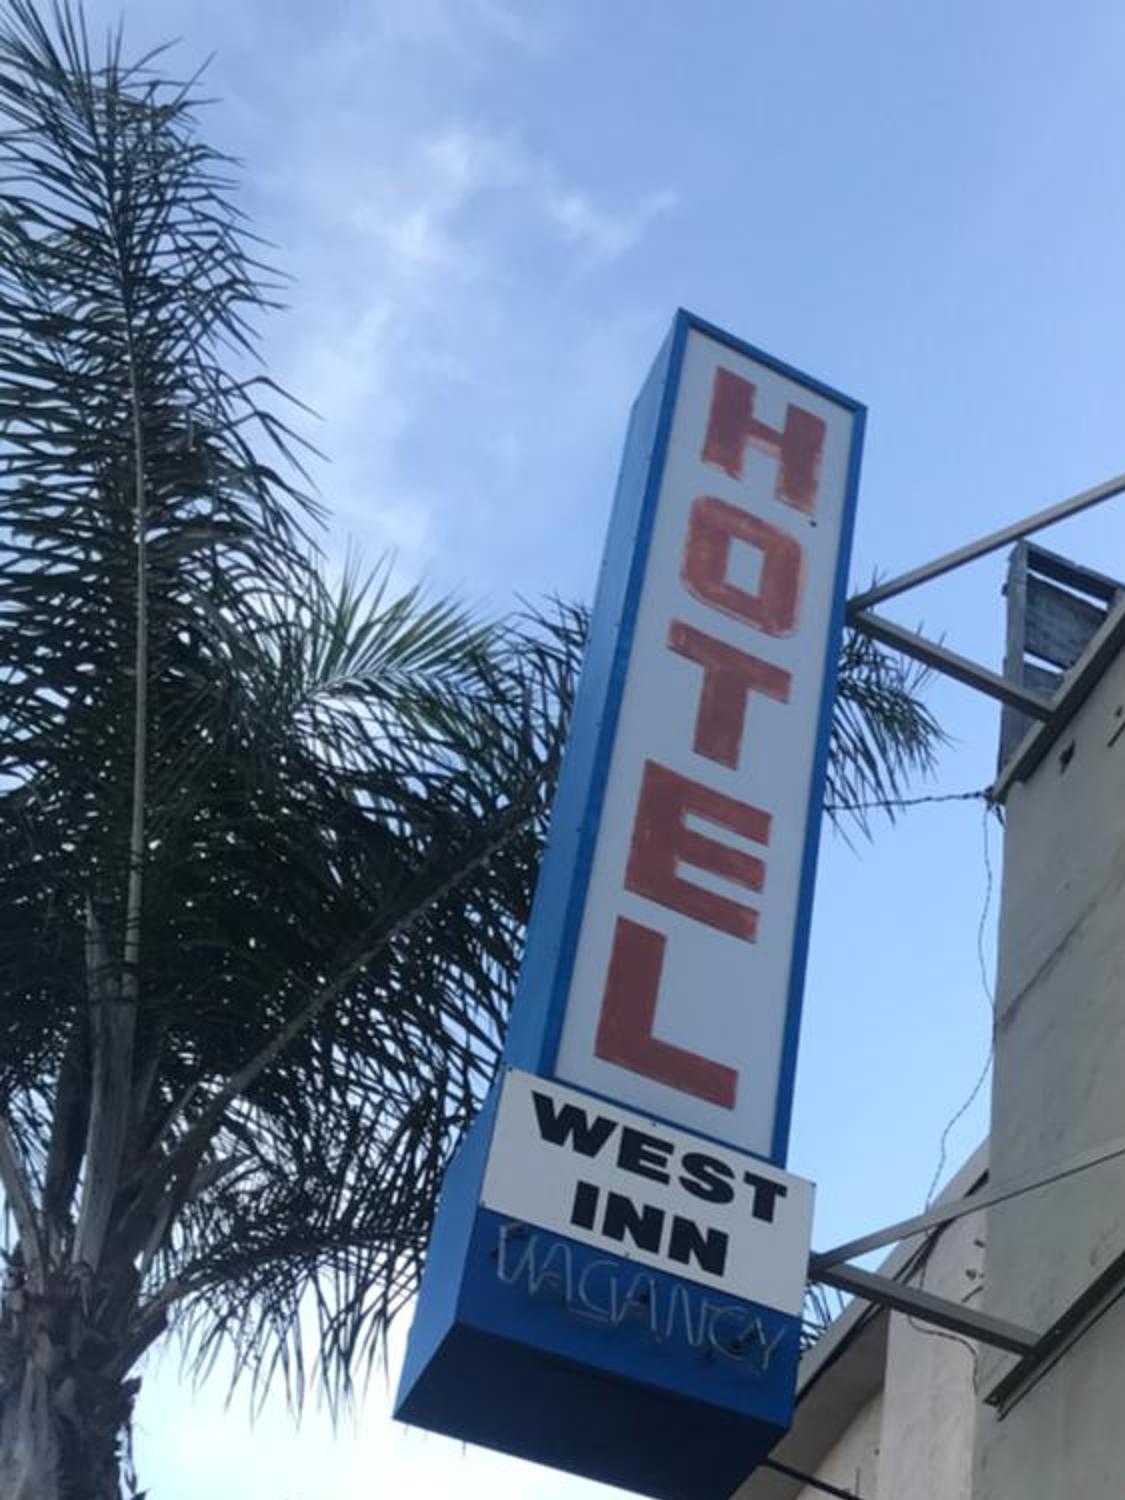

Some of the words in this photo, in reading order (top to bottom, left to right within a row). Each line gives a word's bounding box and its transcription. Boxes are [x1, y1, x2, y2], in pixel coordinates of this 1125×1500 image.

[593, 364, 828, 1111] HOTEL
[531, 1091, 788, 1224] WEST
[570, 1180, 729, 1278] INN
[496, 1226, 788, 1376] VACANCY
